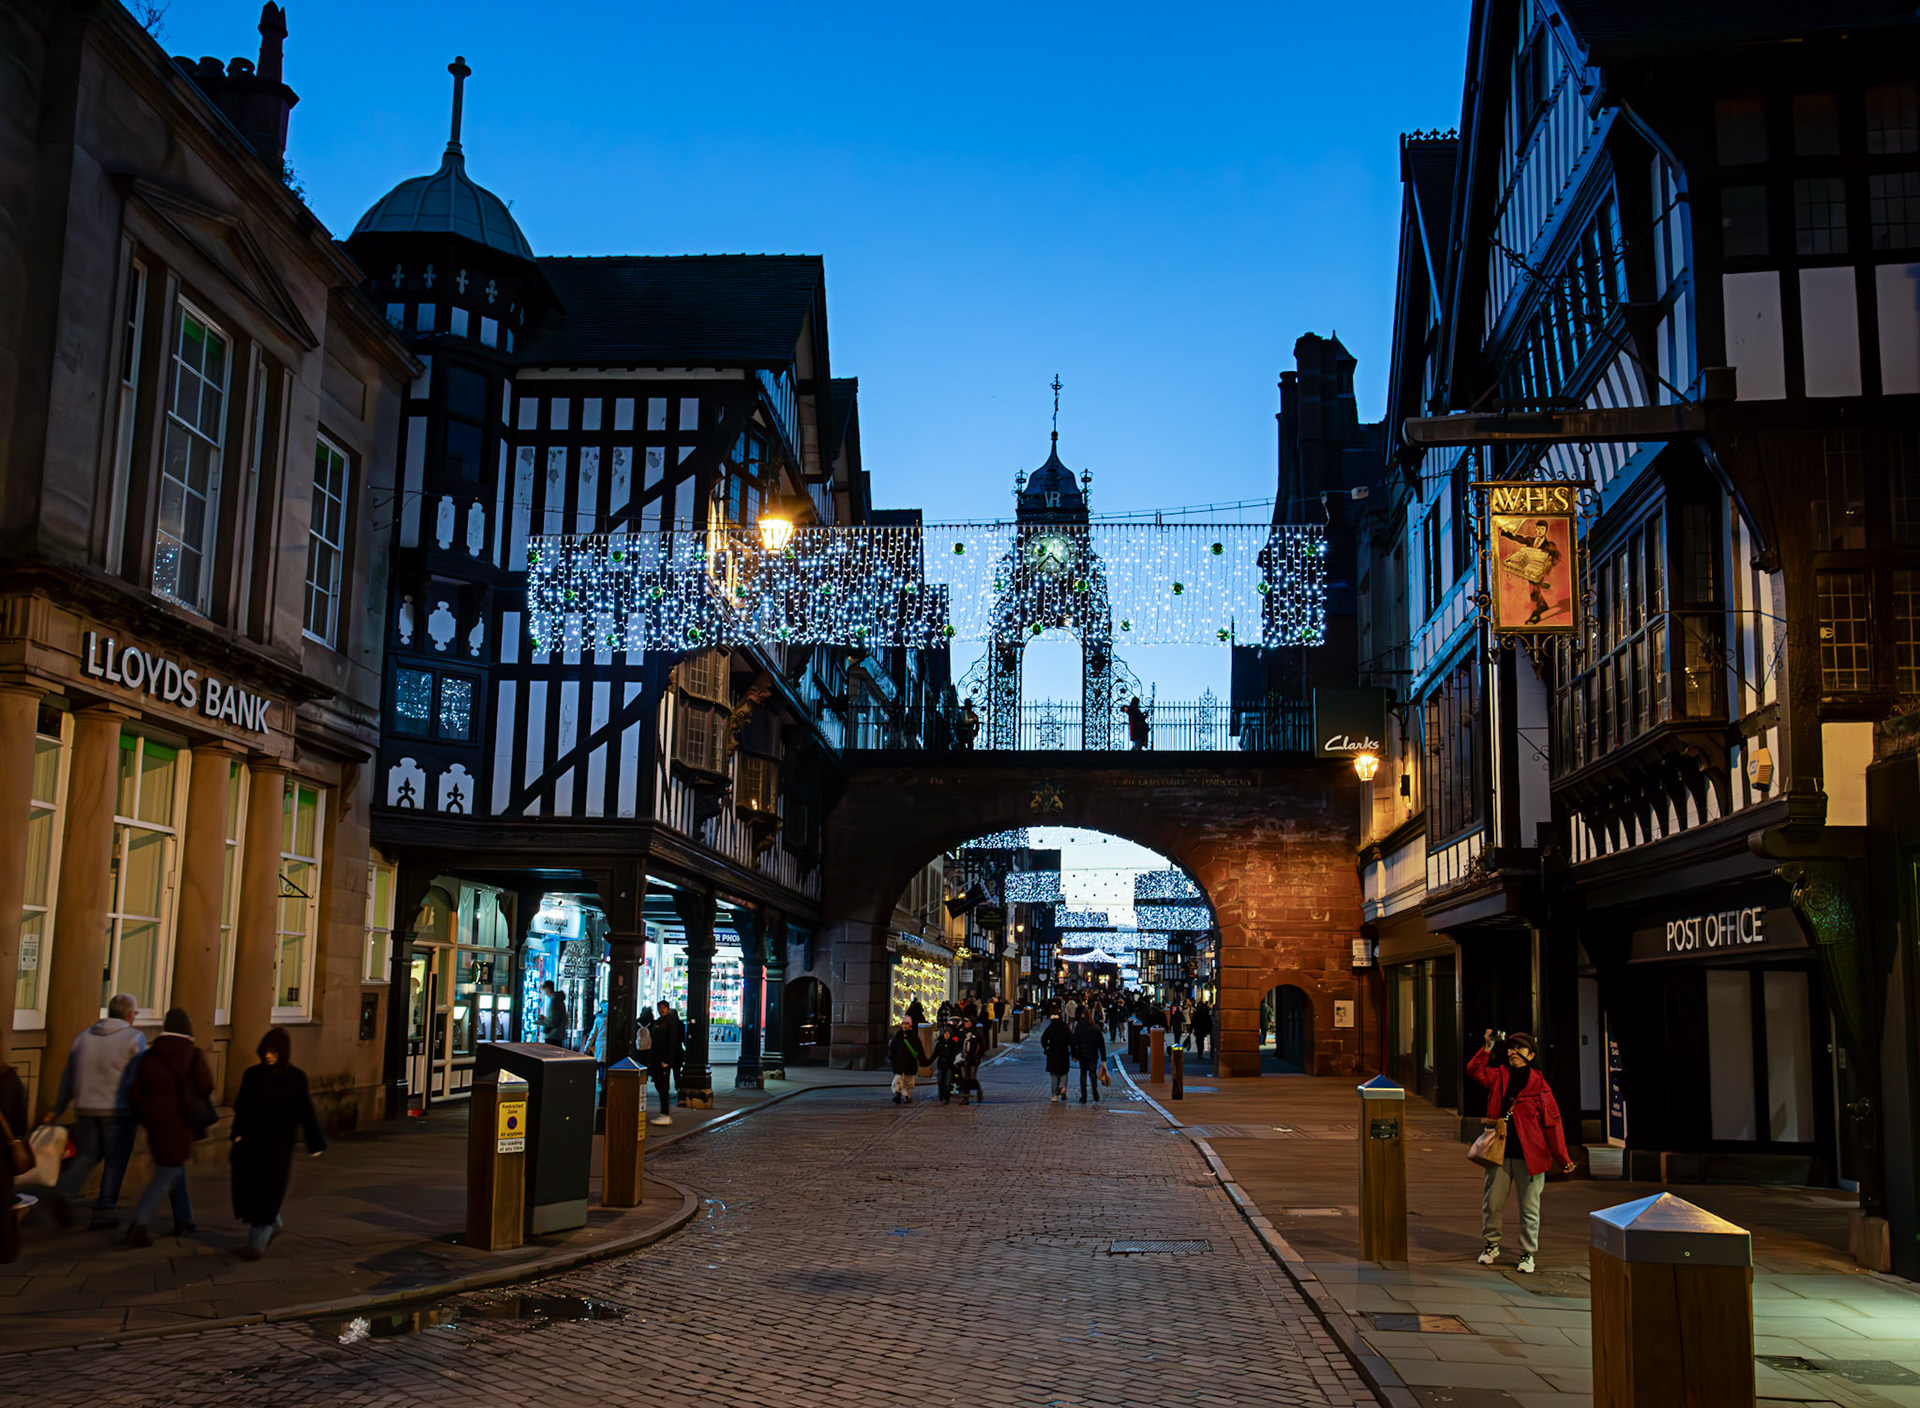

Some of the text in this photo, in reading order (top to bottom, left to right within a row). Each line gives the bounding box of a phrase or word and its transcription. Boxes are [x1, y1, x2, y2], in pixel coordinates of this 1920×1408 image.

[88, 631, 271, 735] LLOYDS BANK
[1324, 735, 1380, 751] Clarks
[1666, 906, 1764, 952] POST OFFICE
